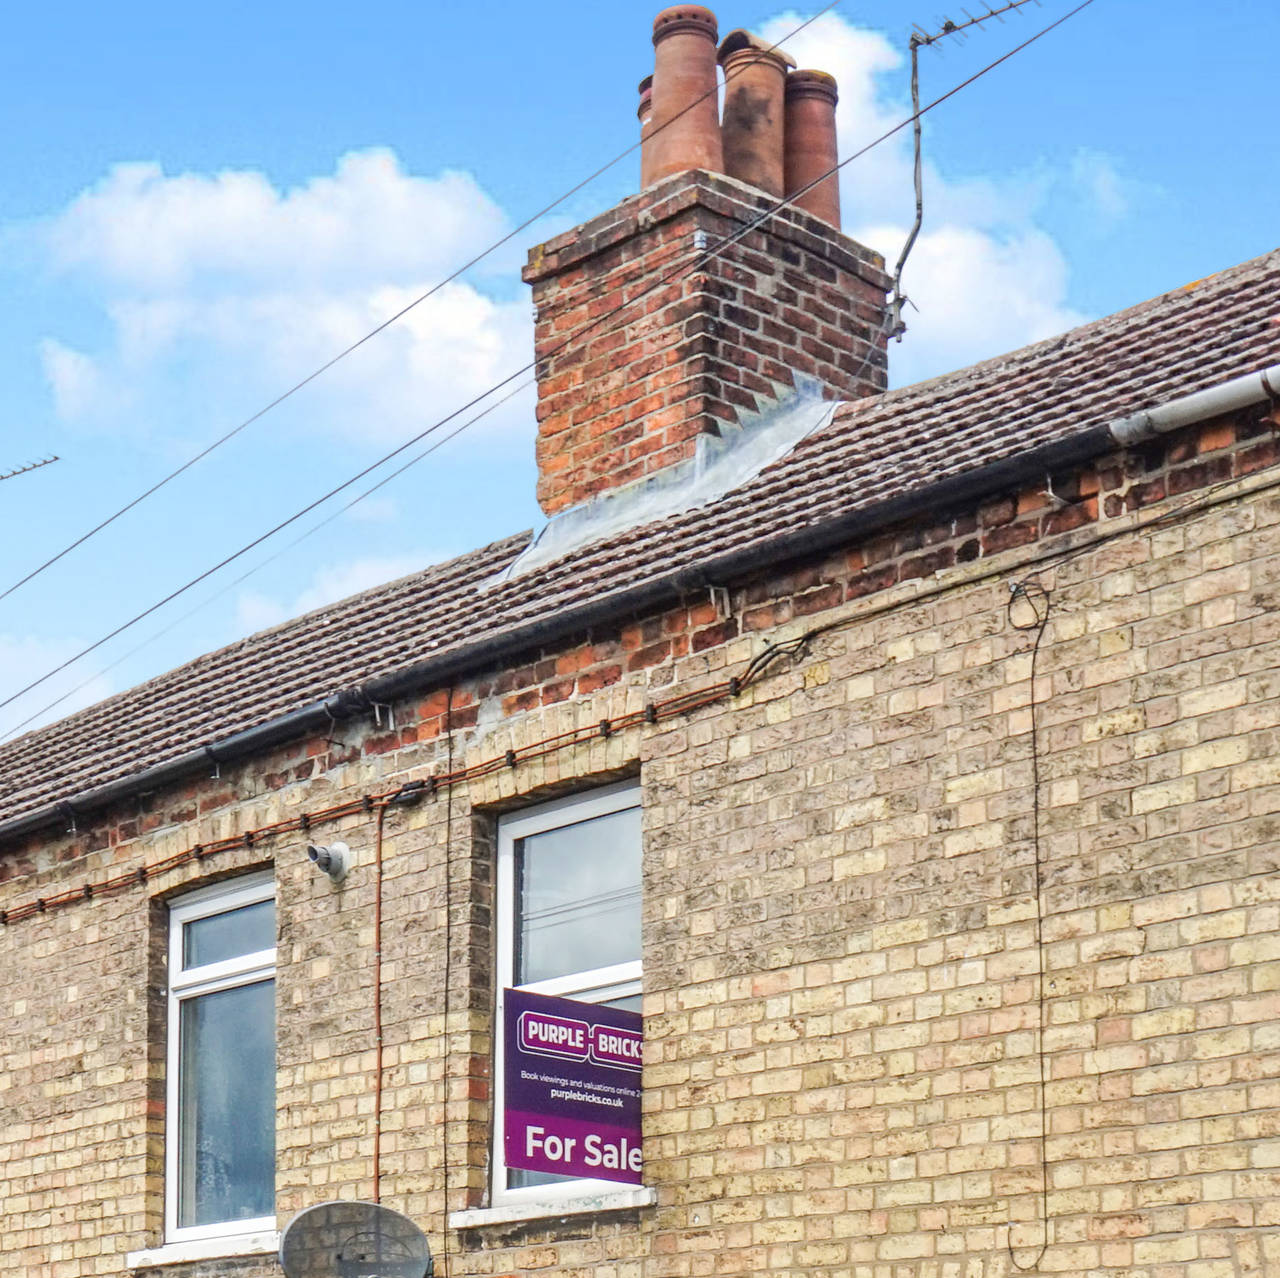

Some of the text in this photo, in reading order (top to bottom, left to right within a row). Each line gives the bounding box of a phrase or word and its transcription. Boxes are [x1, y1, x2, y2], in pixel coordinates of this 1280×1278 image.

[528, 1021, 585, 1049] PURPLE
[521, 1070, 539, 1080] Book
[540, 1073, 568, 1087] viewings
[569, 1078, 582, 1088] and
[583, 1081, 615, 1094] valuations
[616, 1087, 636, 1098] online
[550, 1089, 624, 1108] purplebricks.co.uk
[526, 1125, 643, 1172] For Sale
